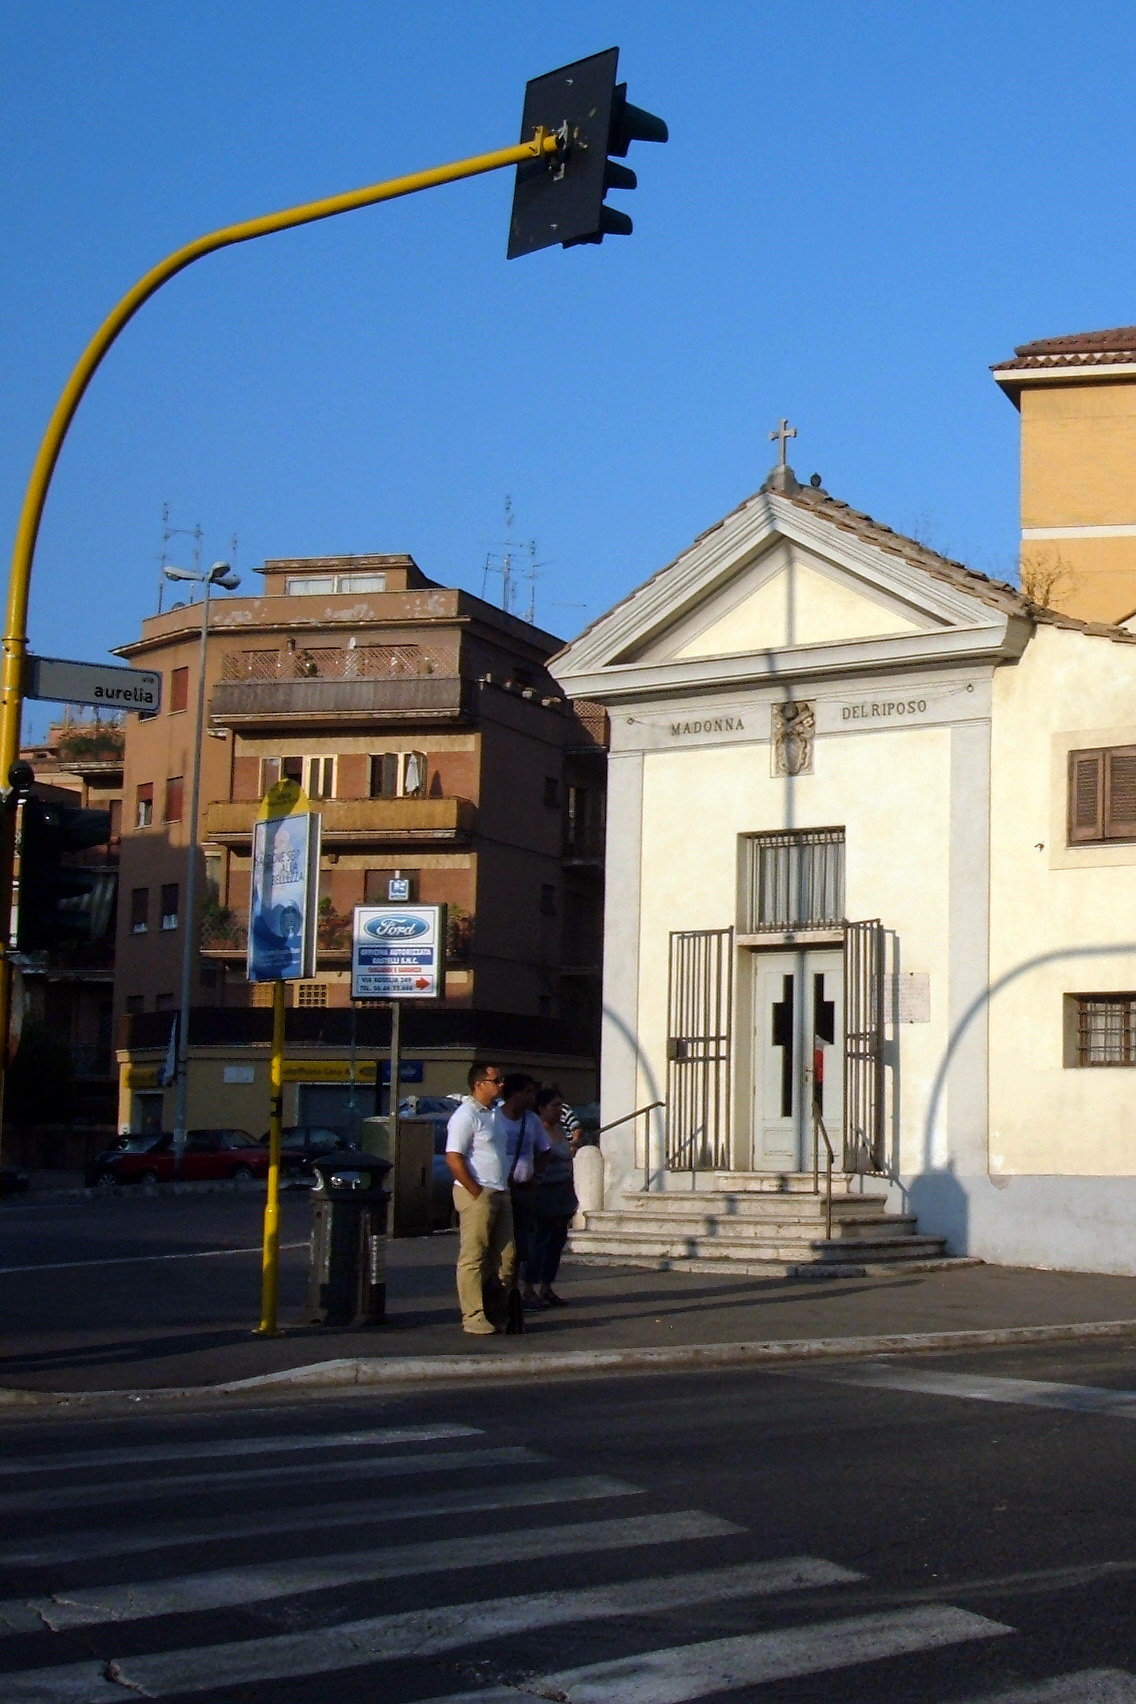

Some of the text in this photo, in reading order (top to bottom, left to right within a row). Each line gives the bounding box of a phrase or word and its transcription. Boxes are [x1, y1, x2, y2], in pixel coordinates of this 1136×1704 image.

[94, 686, 153, 704] aurelia
[671, 699, 927, 736] MADONNA DEL RIPOSO
[376, 918, 416, 936] Ford
